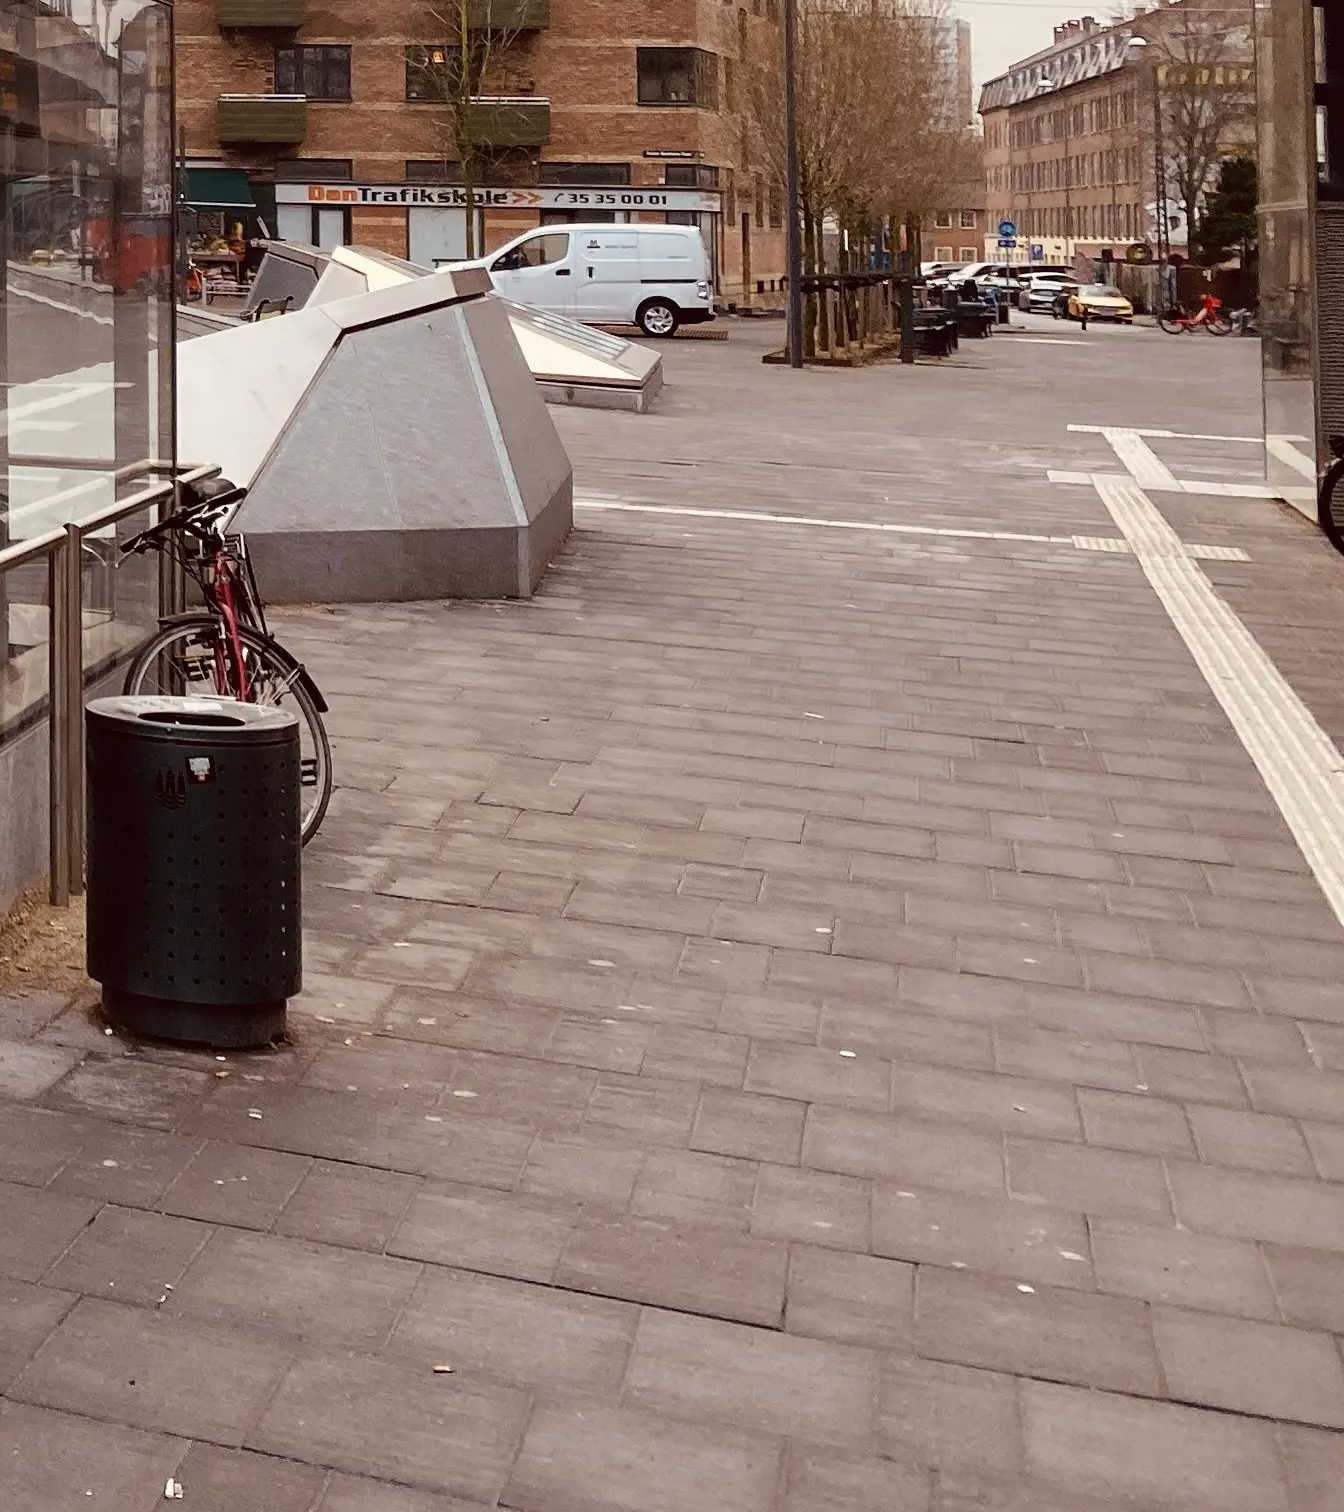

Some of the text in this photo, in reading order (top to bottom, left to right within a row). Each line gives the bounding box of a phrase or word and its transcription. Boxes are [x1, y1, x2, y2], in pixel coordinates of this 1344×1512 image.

[568, 193, 589, 204] 35
[594, 194, 616, 204] 35
[621, 194, 644, 205] 00
[648, 195, 667, 205] 01
